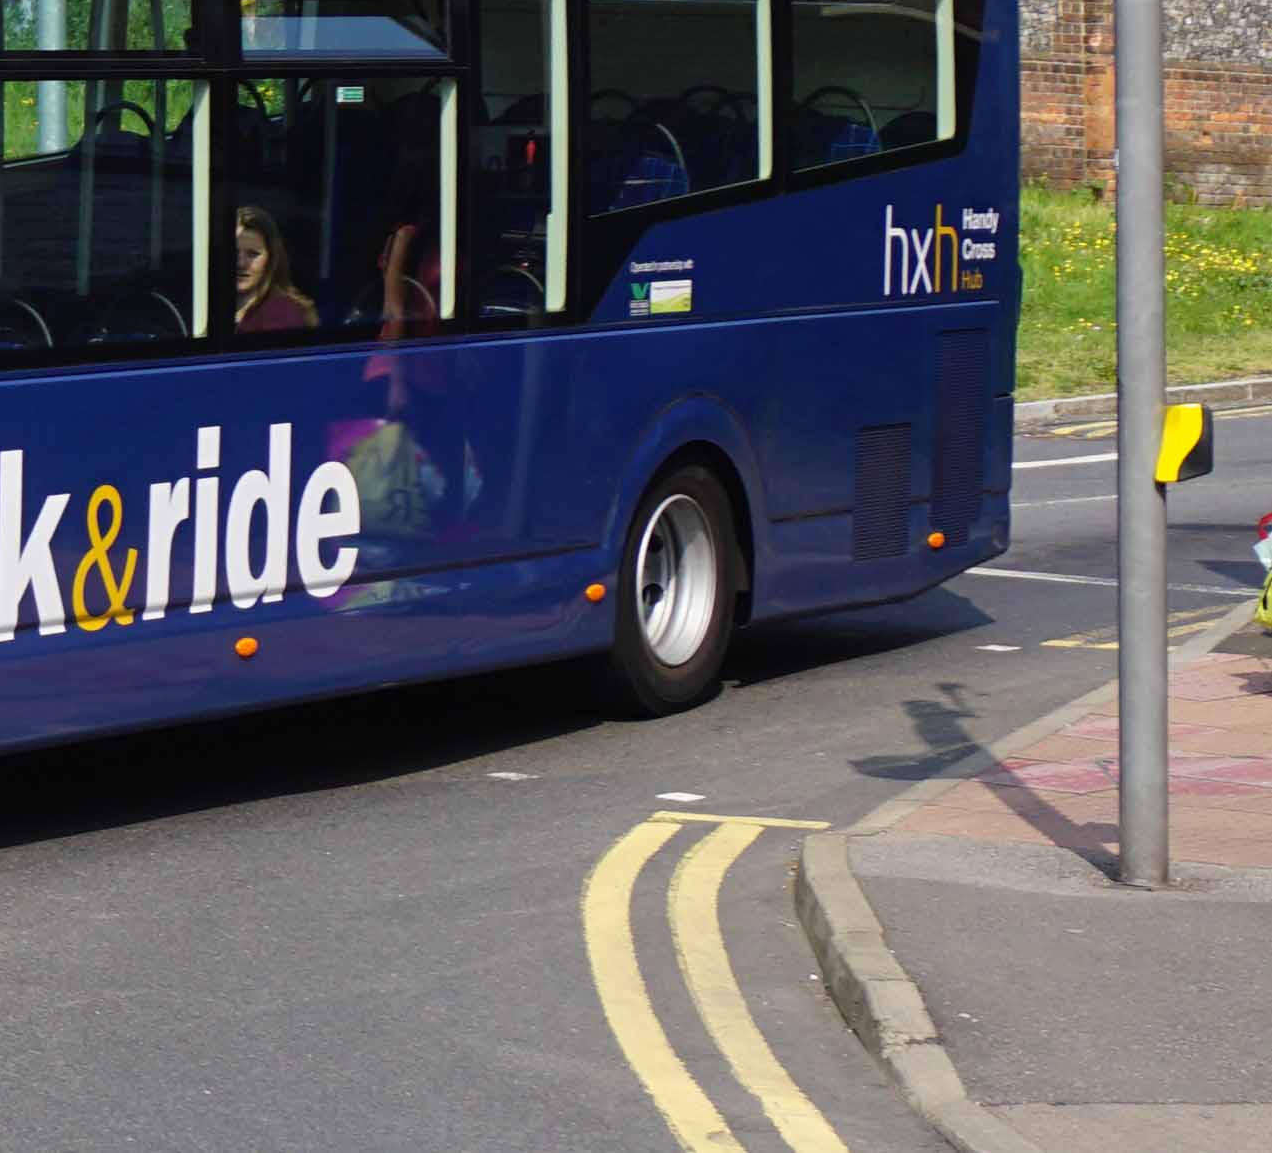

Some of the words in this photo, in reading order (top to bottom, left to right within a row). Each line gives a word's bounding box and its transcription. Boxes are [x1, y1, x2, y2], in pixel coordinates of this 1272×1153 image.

[962, 207, 1000, 234] Handy
[884, 203, 958, 296] hxh
[962, 238, 996, 261] Cross
[961, 268, 983, 290] Hub
